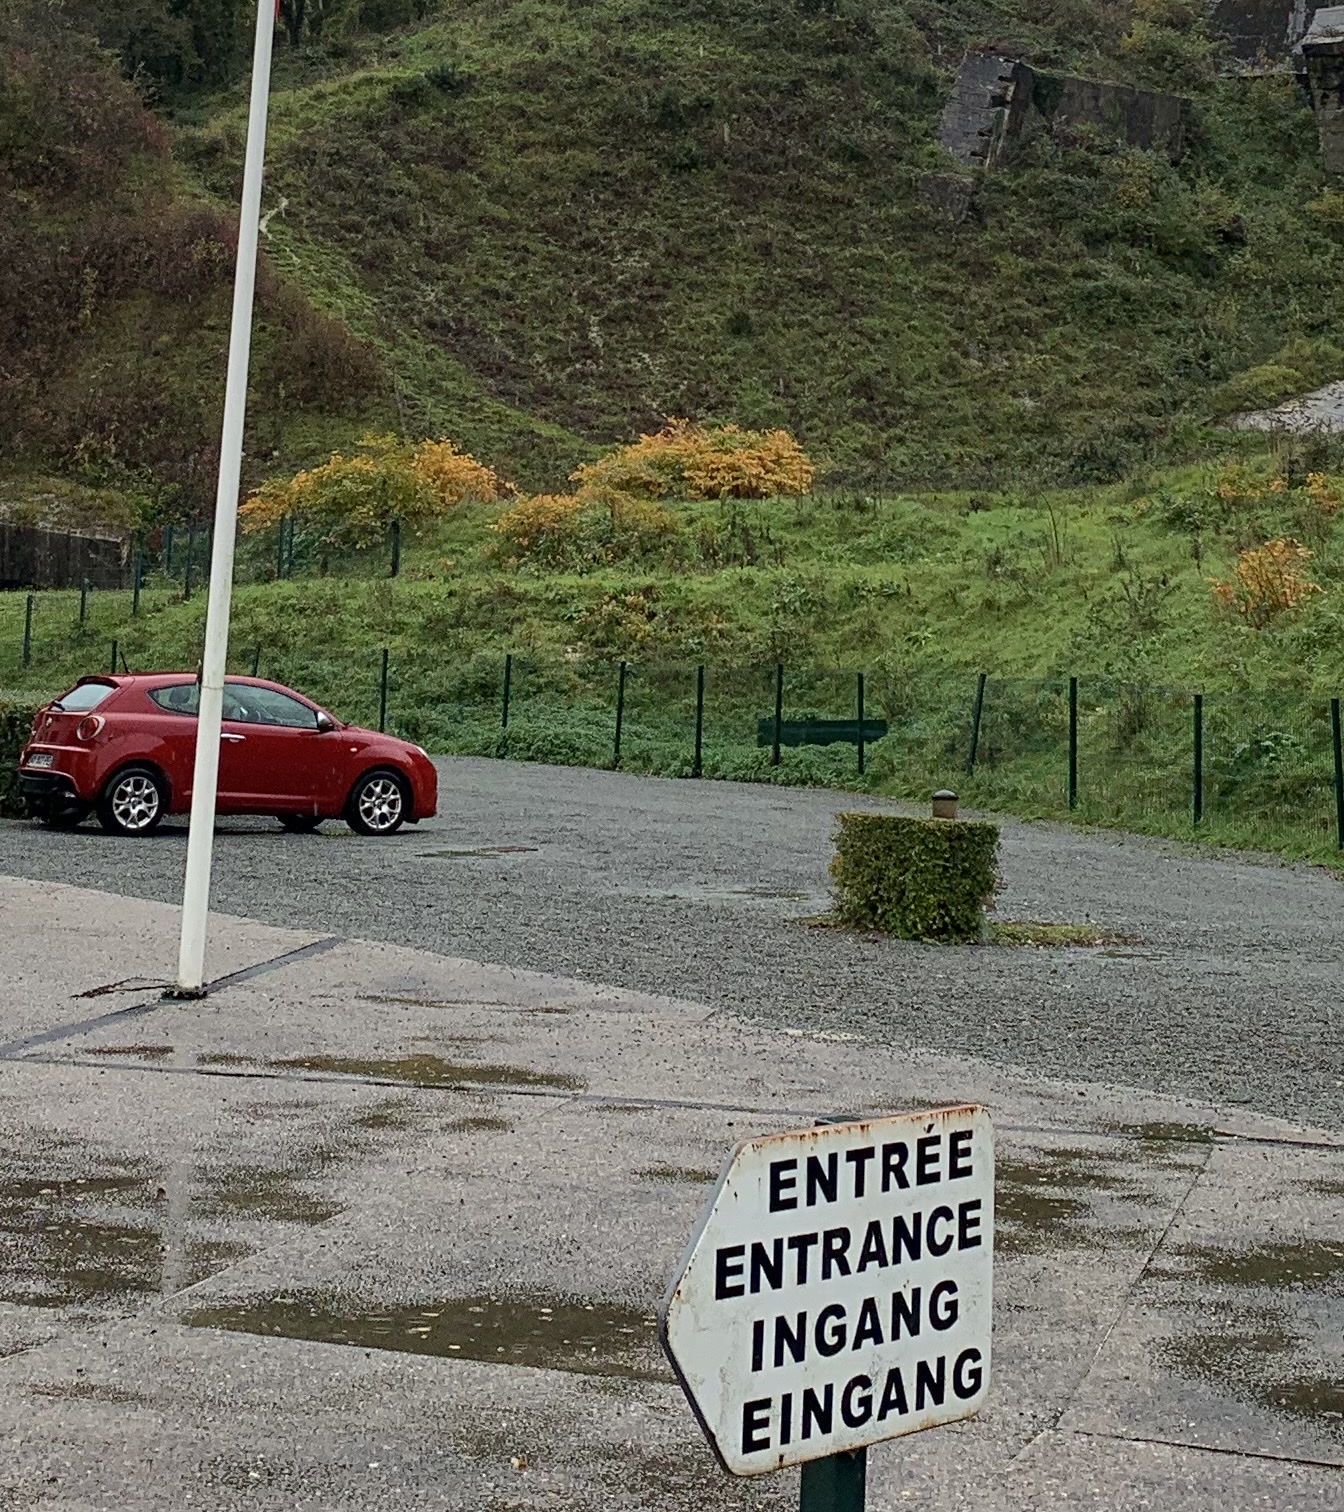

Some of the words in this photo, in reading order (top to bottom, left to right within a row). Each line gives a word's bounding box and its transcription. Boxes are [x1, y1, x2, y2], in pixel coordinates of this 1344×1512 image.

[769, 1124, 974, 1213] ENTRÉE
[714, 1199, 983, 1301] ENTRANCE
[751, 1280, 959, 1372] INGANG
[742, 1348, 983, 1455] EINGANG
